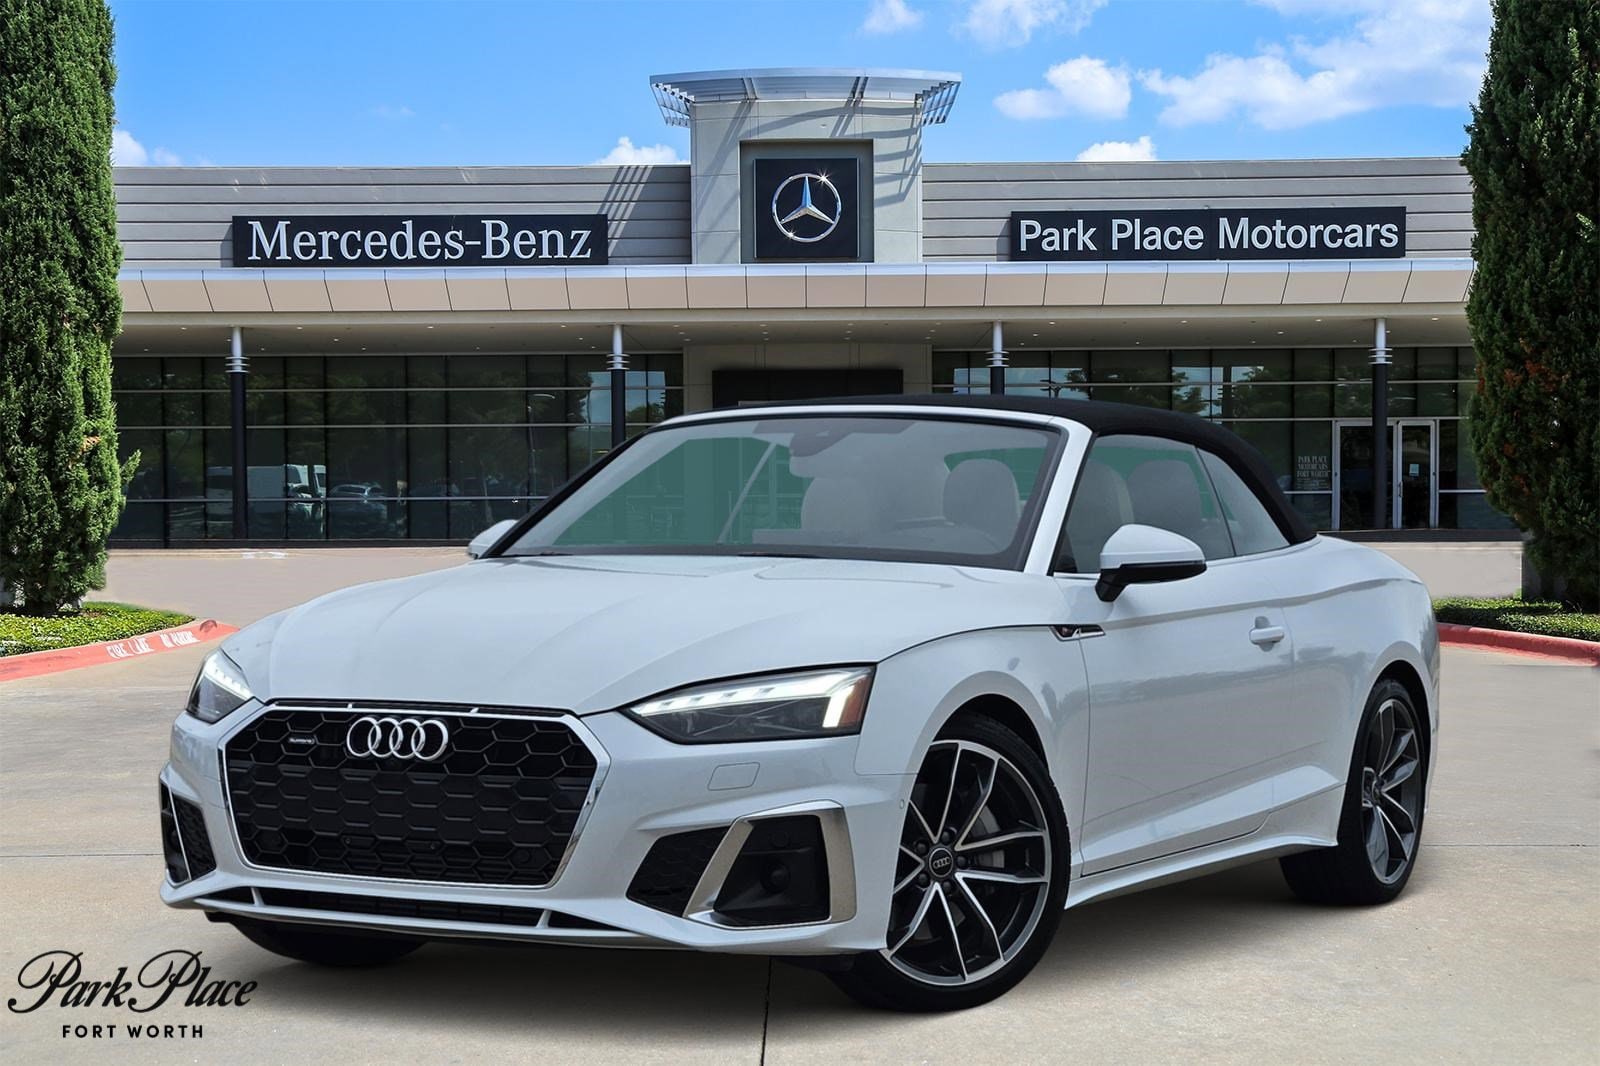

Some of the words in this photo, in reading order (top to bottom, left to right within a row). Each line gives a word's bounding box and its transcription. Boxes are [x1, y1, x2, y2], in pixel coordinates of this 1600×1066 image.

[247, 219, 593, 261] Mercedes-Benz
[1019, 218, 1097, 252] Park
[1110, 217, 1204, 251] Place
[1218, 216, 1400, 250] Motorcars
